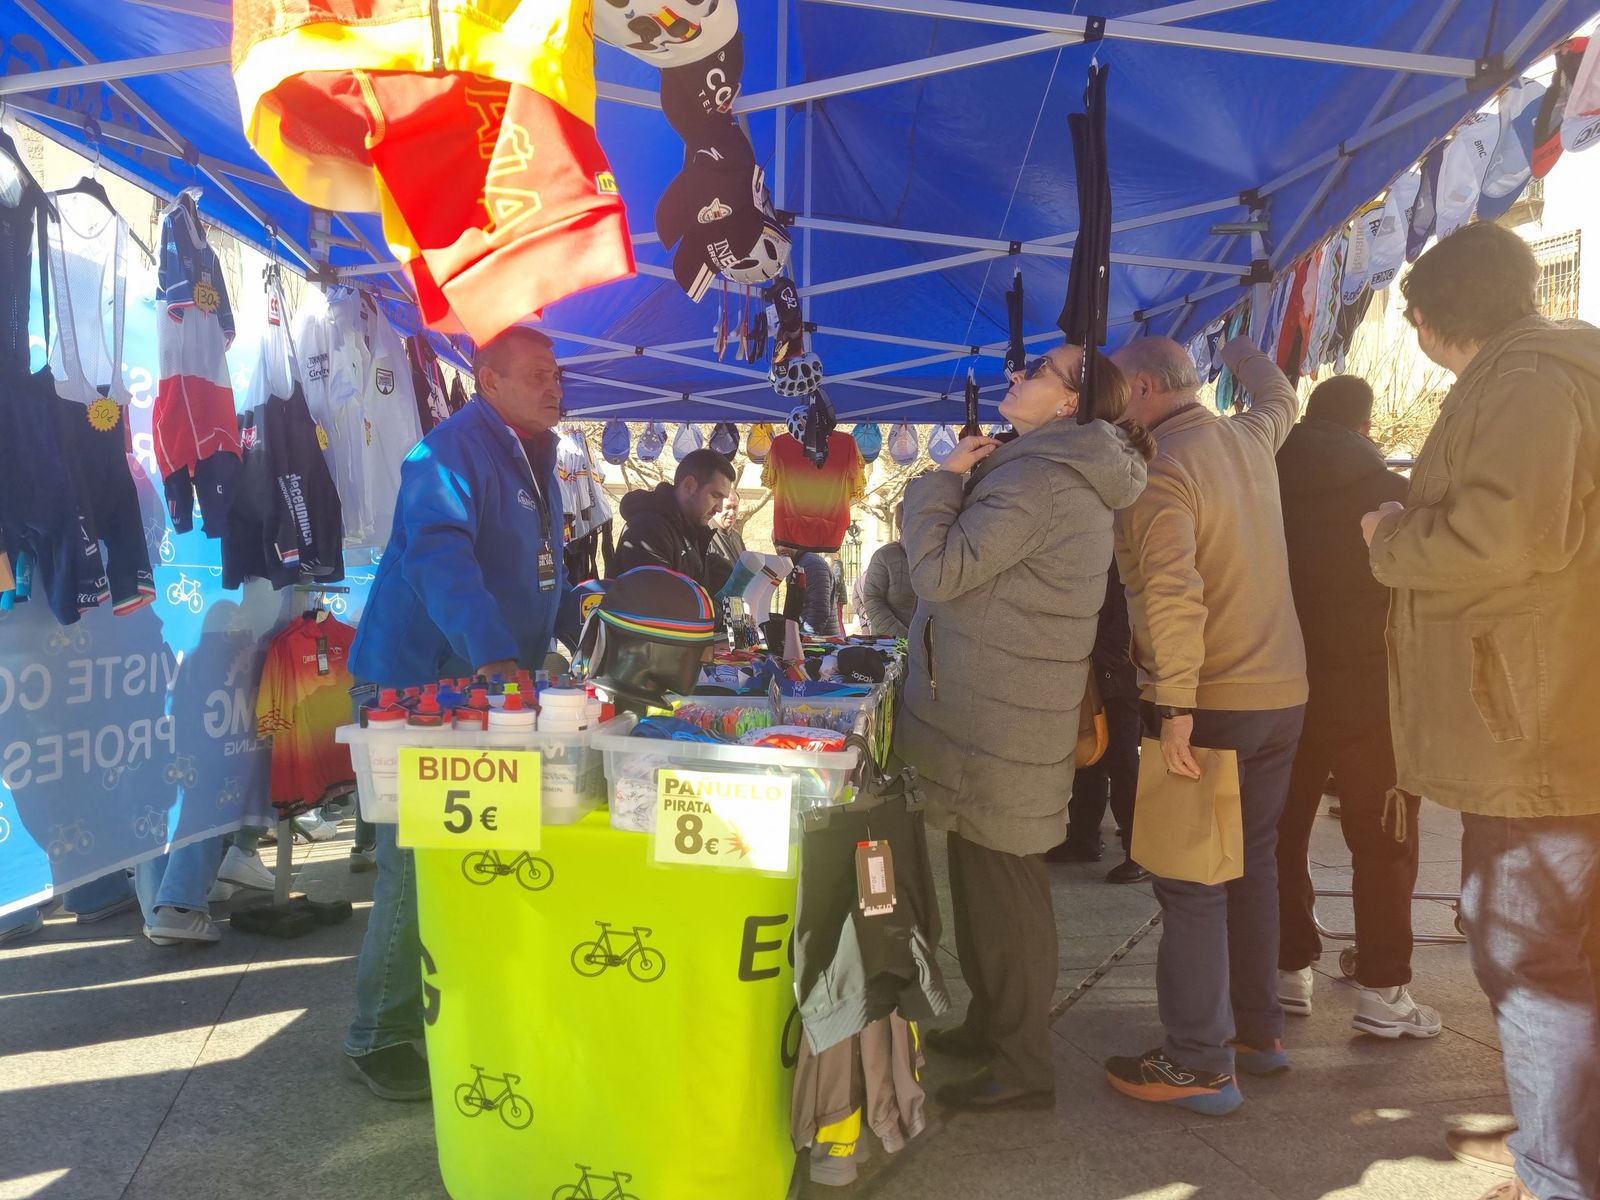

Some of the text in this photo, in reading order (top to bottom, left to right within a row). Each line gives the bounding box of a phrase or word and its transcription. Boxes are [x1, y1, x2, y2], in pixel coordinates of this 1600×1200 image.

[706, 67, 733, 107] CO
[714, 238, 740, 267] INE
[418, 752, 518, 783] BIDÓN
[664, 778, 782, 801] PAÑUELO
[663, 799, 712, 814] PIRATA
